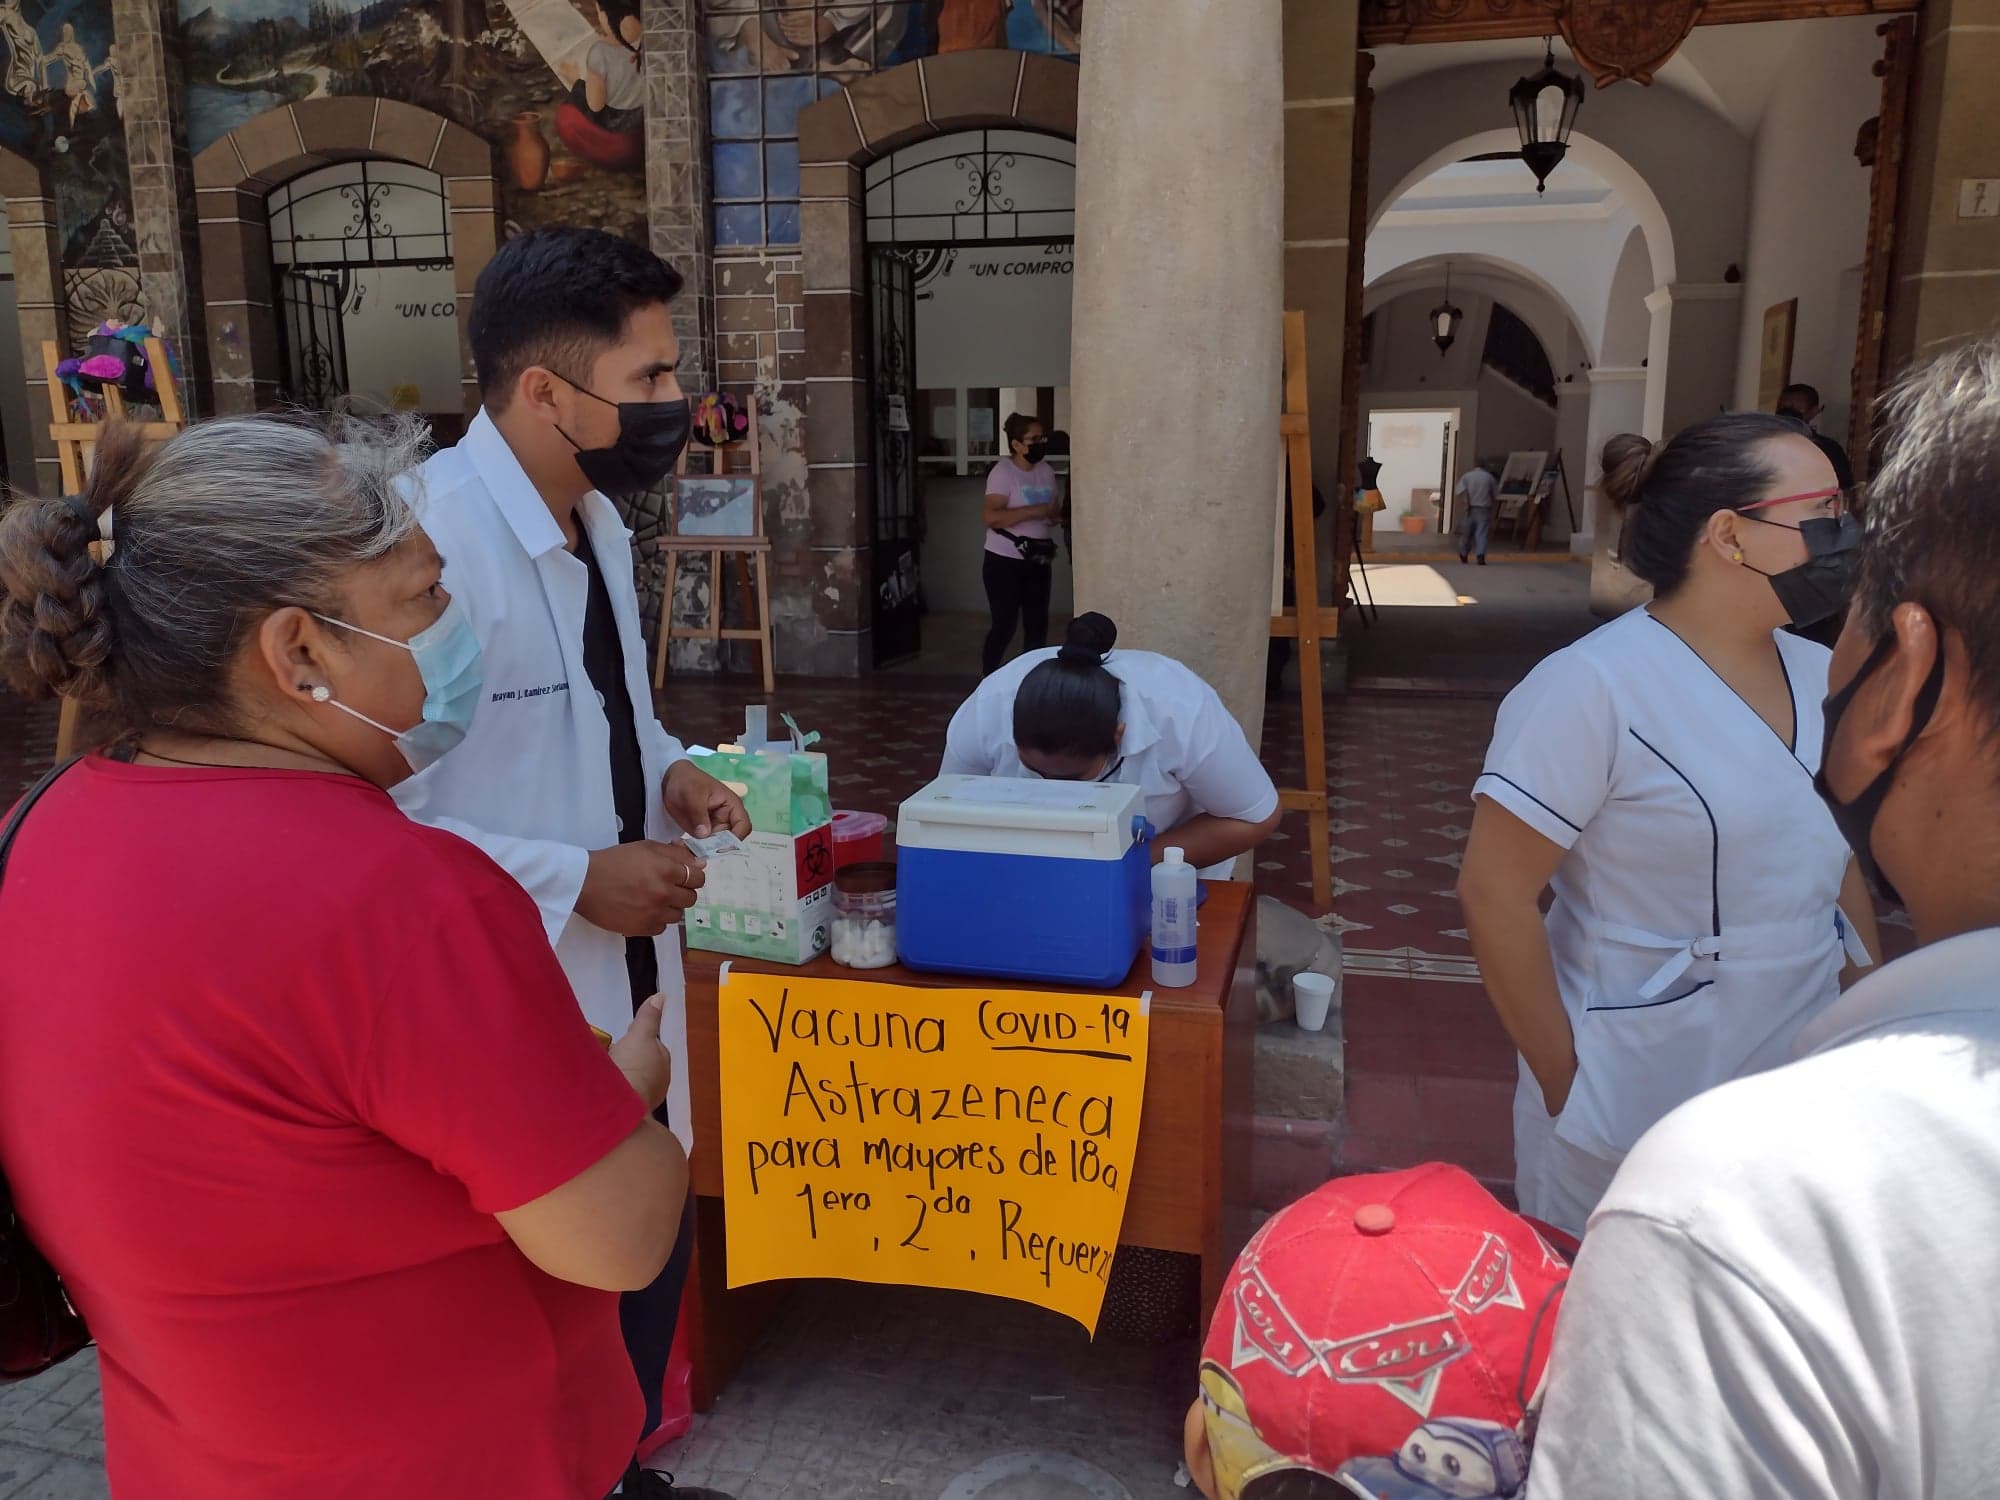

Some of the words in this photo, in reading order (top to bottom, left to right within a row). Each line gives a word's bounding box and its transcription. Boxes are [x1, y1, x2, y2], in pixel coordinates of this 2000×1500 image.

[749, 988, 945, 1053] Vacuna
[978, 1000, 1131, 1044] COVID-19
[784, 1061, 1113, 1139] Astrazeneca
[748, 1138, 840, 1194] para
[864, 1137, 1004, 1190] mayores
[1019, 1133, 1057, 1176] de
[1466, 1250, 1505, 1304] Cars
[1239, 1279, 1293, 1357] Cars
[1340, 1330, 1458, 1373] Cars
